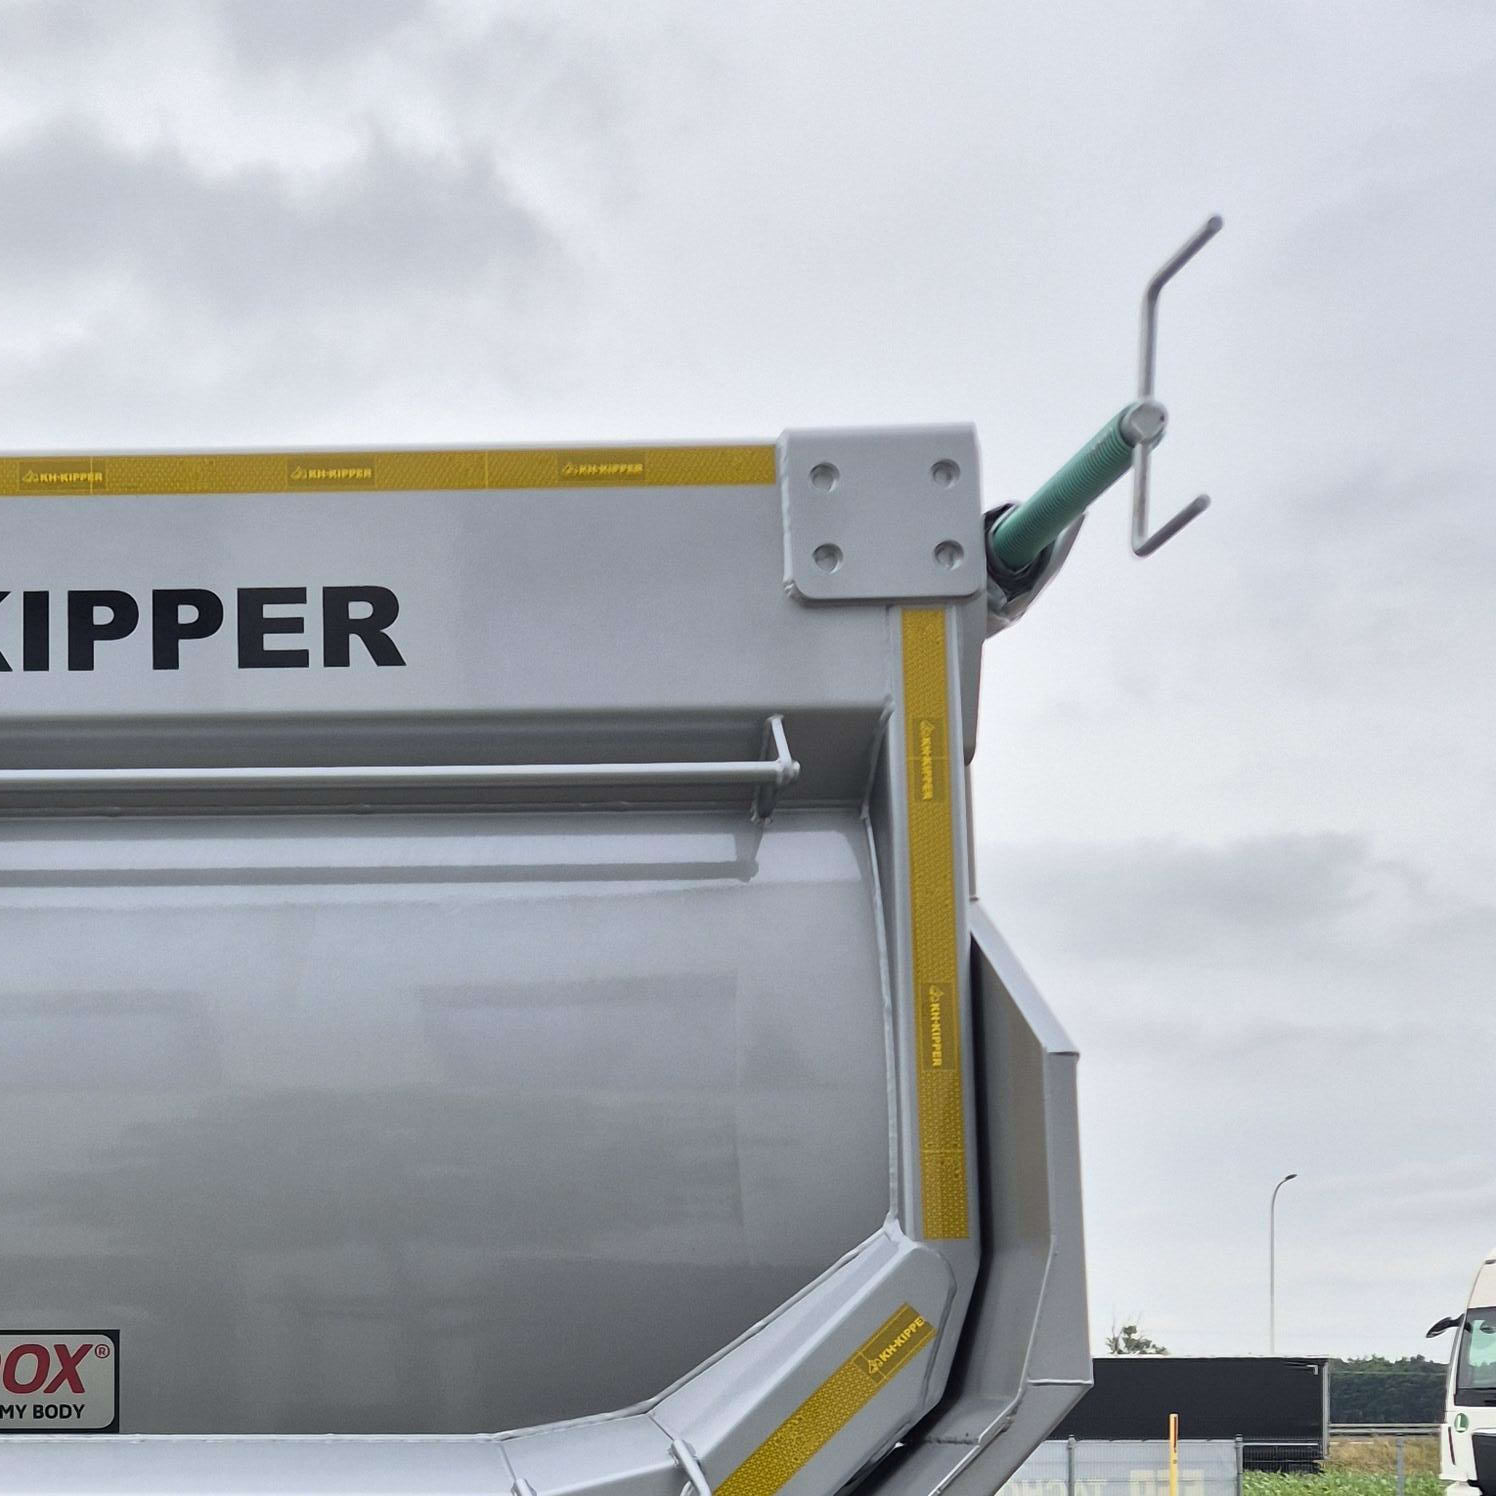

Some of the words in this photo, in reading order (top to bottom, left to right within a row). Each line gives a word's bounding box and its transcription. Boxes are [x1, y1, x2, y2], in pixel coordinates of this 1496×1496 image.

[308, 468, 372, 479] KH-KIPPER
[577, 463, 643, 475] KH-KIPPER
[40, 472, 102, 482] KH-KIPPER
[930, 1003, 942, 1066] KH-KIPPER
[32, 1404, 85, 1420] BODY
[1457, 1415, 1466, 1431] L
